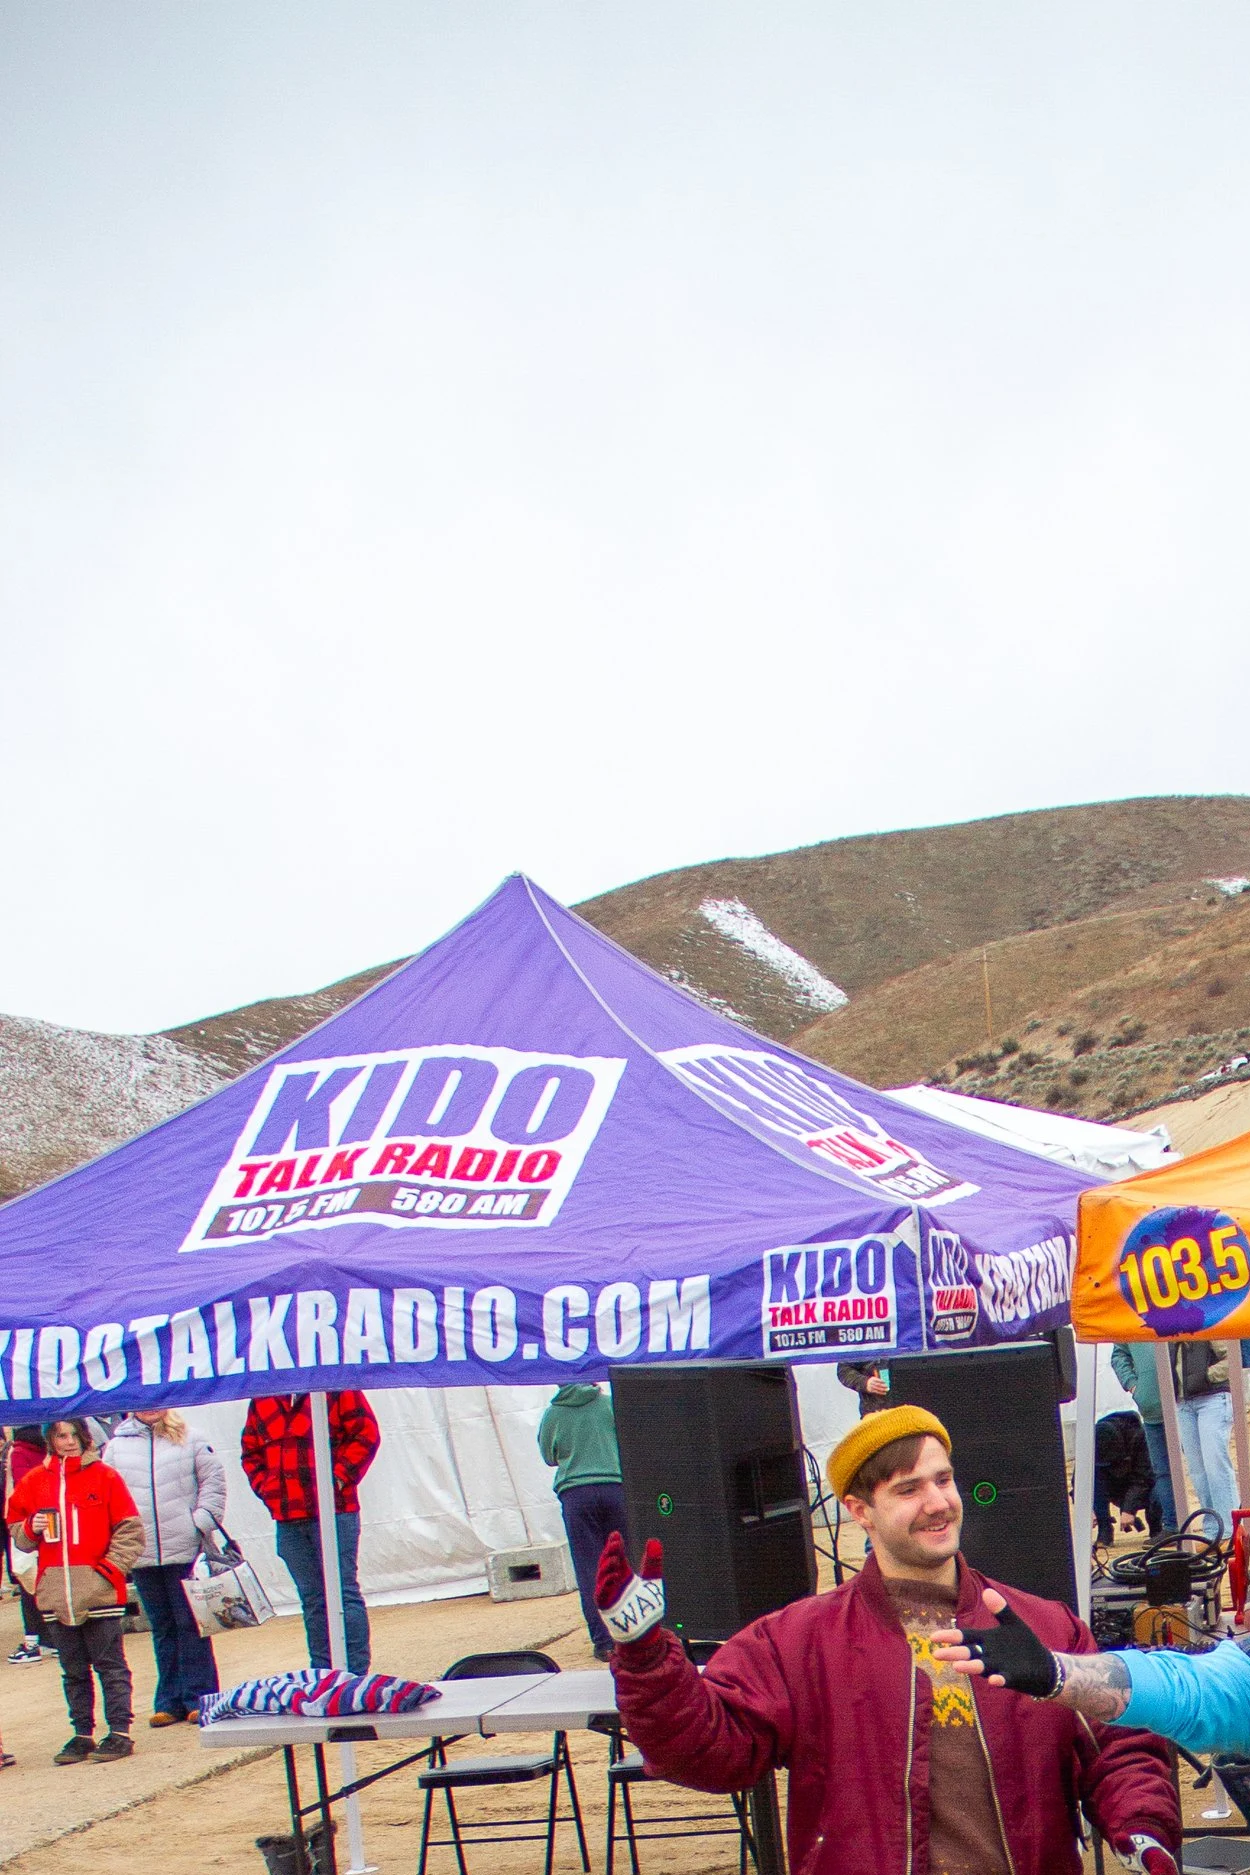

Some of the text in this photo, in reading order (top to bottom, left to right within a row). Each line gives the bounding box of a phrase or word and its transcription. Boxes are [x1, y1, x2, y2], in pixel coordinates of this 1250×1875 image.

[245, 1056, 598, 1158] KIDO
[231, 1142, 564, 1199] TALK RADIO
[226, 1187, 528, 1233] 107.5 FM 580 AM
[769, 1239, 888, 1304] KIDO
[768, 1296, 889, 1328] TALK RADIO
[774, 1325, 886, 1347] 107.5 FM 580 AM
